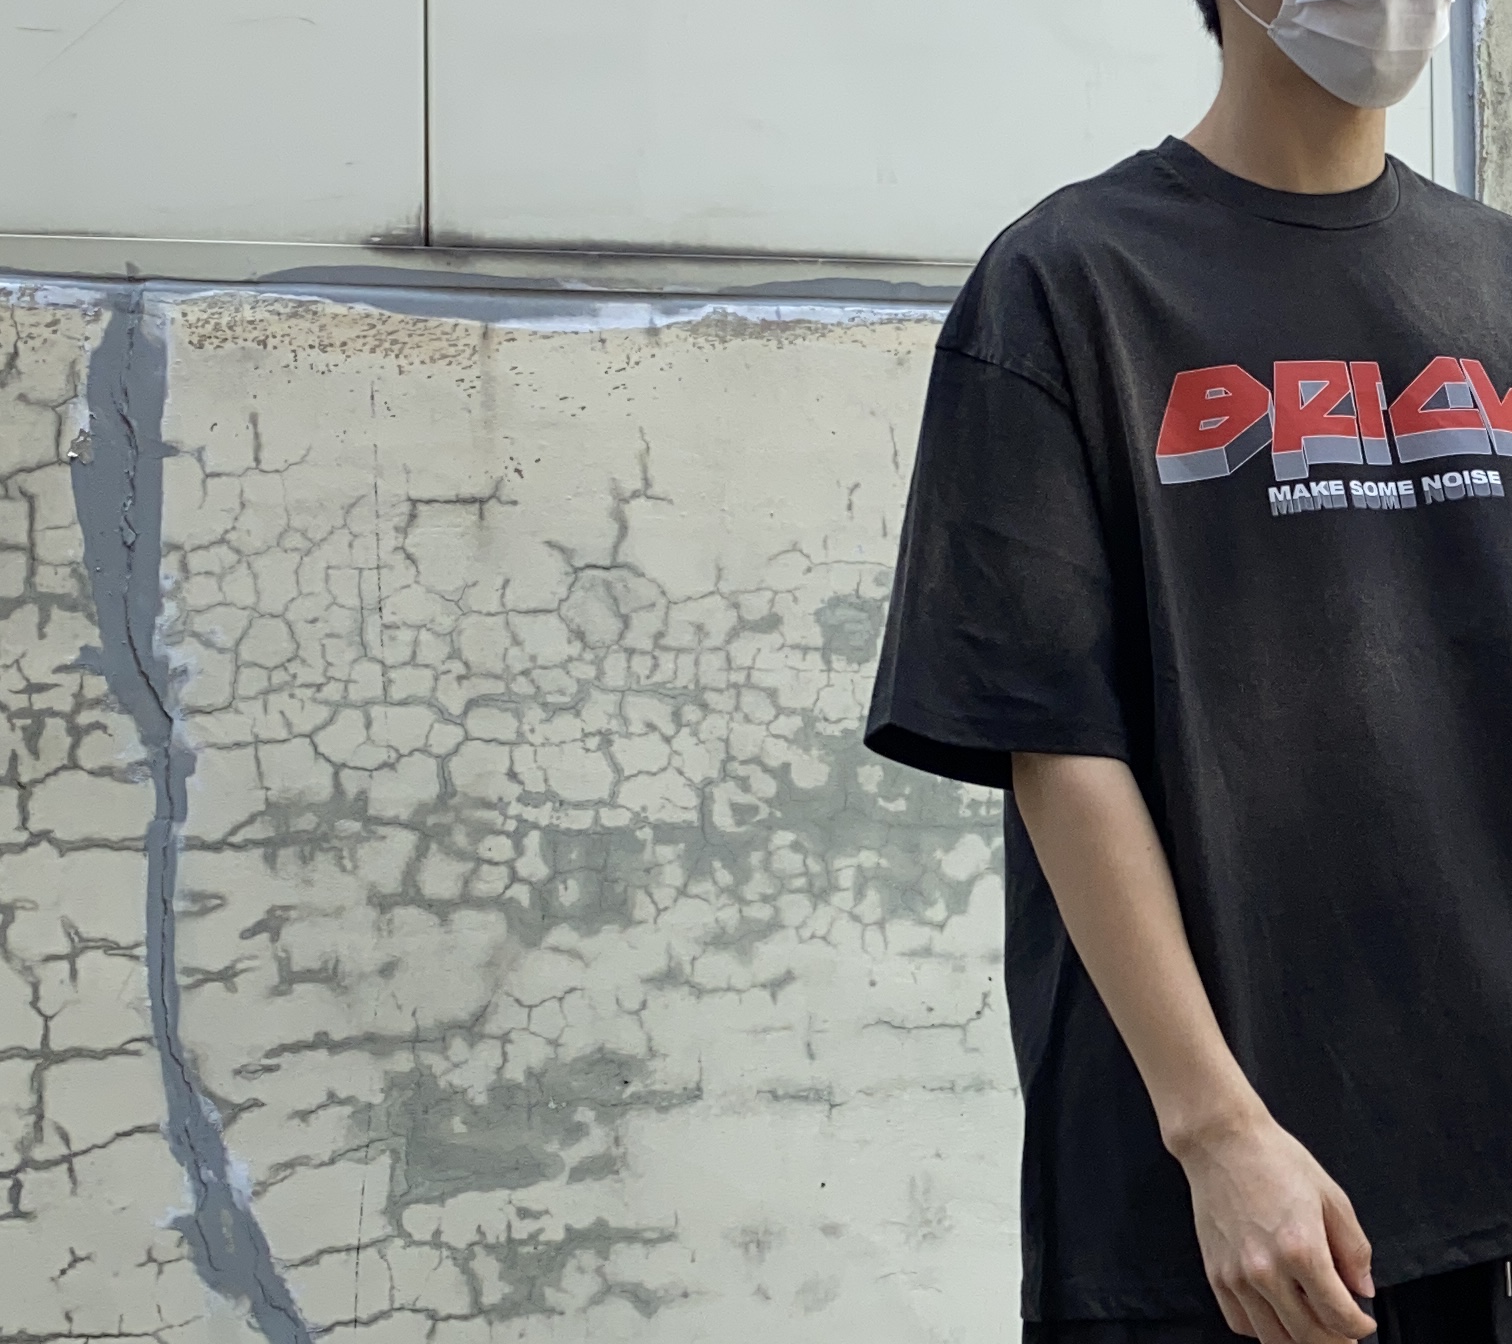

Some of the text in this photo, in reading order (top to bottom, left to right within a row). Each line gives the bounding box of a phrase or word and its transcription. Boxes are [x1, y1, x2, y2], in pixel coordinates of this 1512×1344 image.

[1268, 468, 1505, 513] MAKE SOME NOISE
